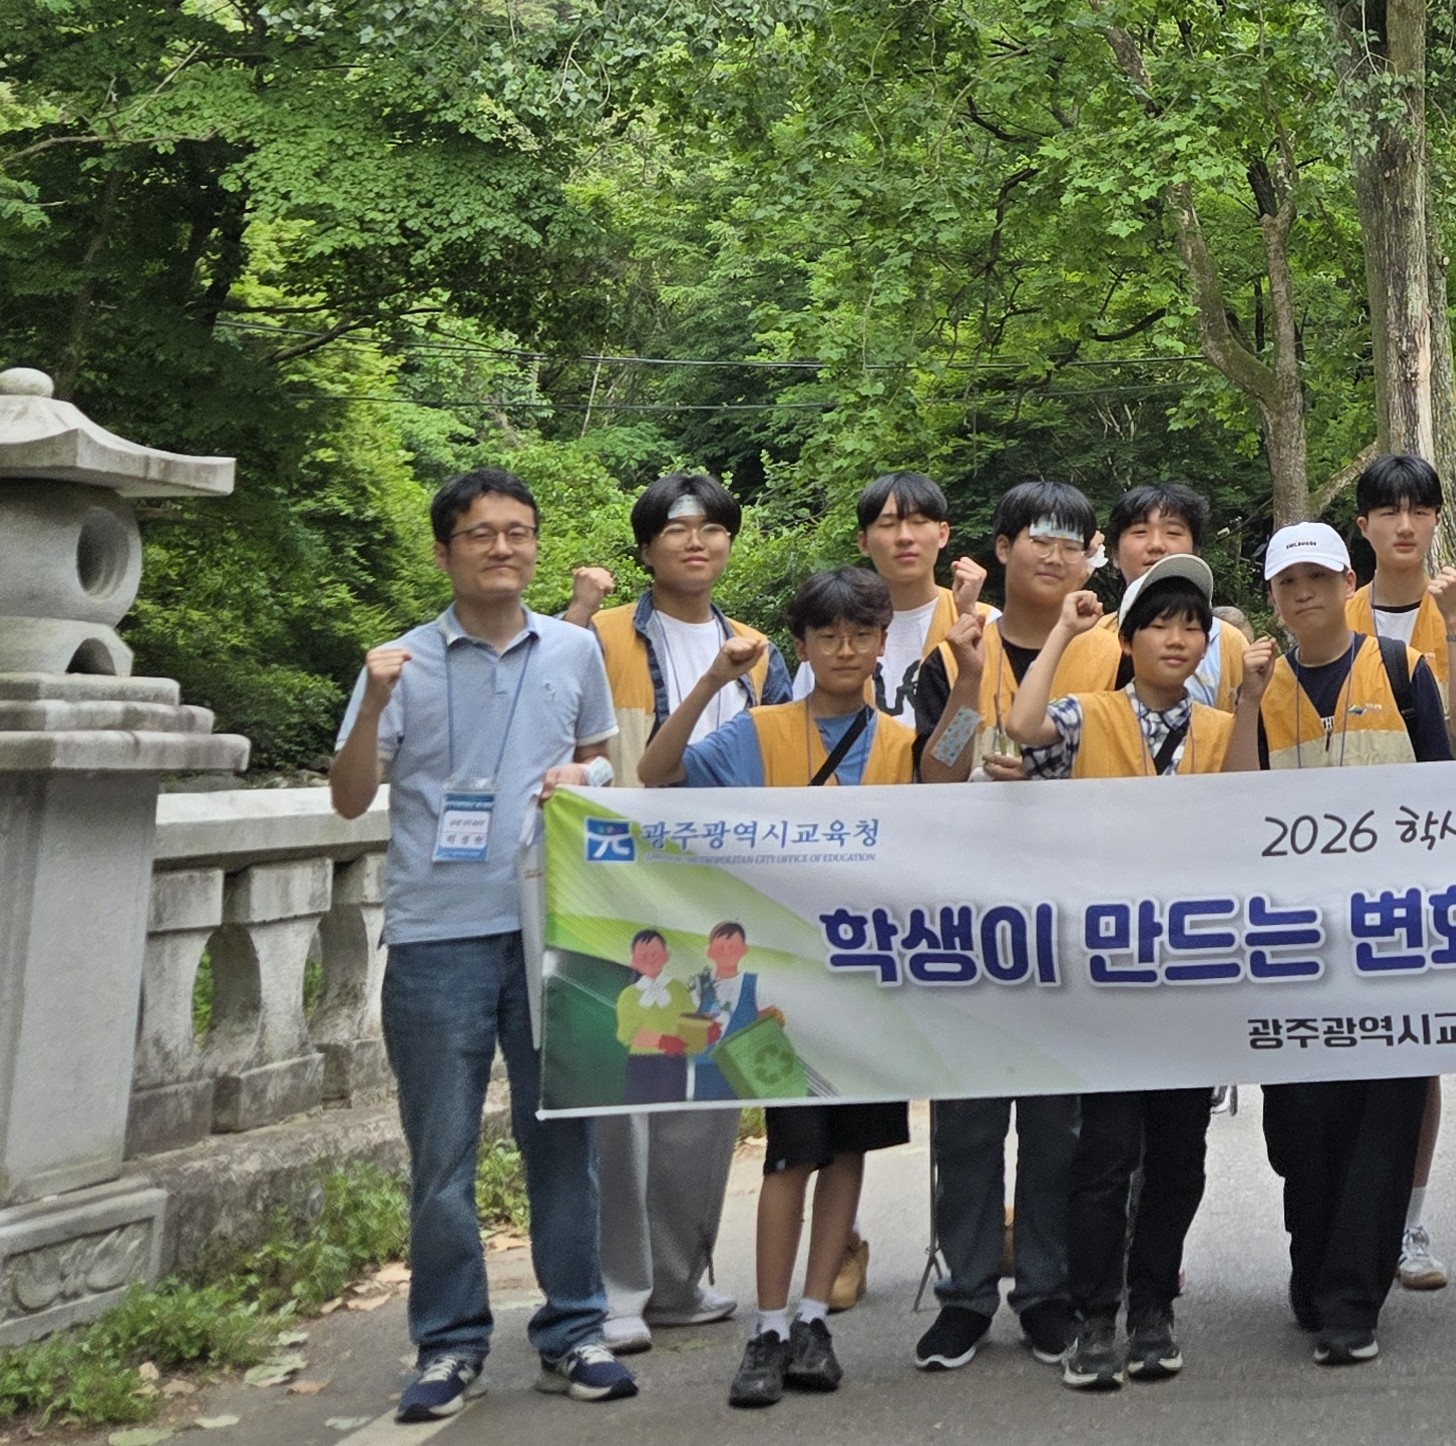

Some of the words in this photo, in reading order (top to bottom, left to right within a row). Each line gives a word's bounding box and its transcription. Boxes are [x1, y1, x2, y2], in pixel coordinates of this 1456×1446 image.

[641, 818, 879, 850] 광주광역시교육청
[1261, 809, 1379, 858] 2026
[820, 902, 1057, 984] 학생이
[1085, 896, 1323, 983] 만드는
